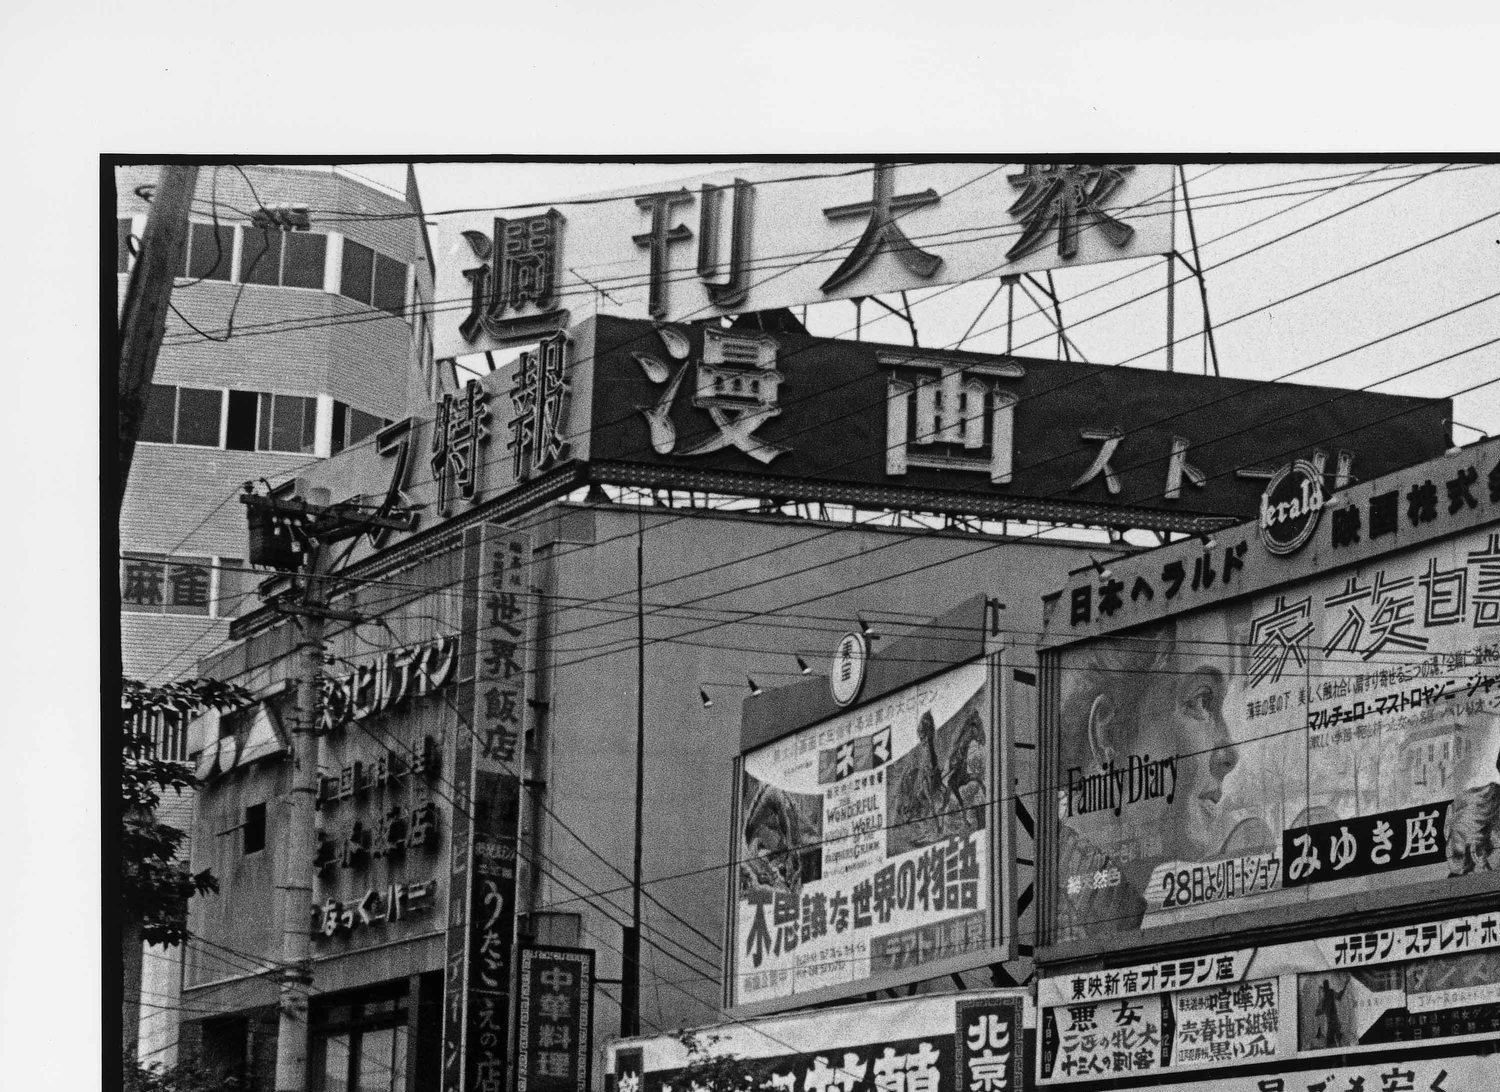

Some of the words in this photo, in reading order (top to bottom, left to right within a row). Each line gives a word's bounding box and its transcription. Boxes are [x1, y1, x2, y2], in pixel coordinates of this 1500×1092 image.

[124, 562, 212, 605] 麻雀
[1069, 542, 1249, 628] 日本ヘラルド
[482, 592, 523, 763] 世界飯店
[1067, 760, 1126, 818] Family
[1127, 752, 1179, 806] Diary
[1289, 806, 1440, 881] みゆき座
[745, 838, 980, 968] 不思議な世界の物語
[1071, 955, 1236, 1002] 東映新宿オデヲン座
[538, 965, 572, 1081] 中華料理
[1064, 1000, 1144, 1032] 悪女
[1178, 1008, 1280, 1044] 売春地下組織
[1061, 1046, 1155, 1077] 十三人の刺客
[1208, 1034, 1276, 1062] 黒い爪
